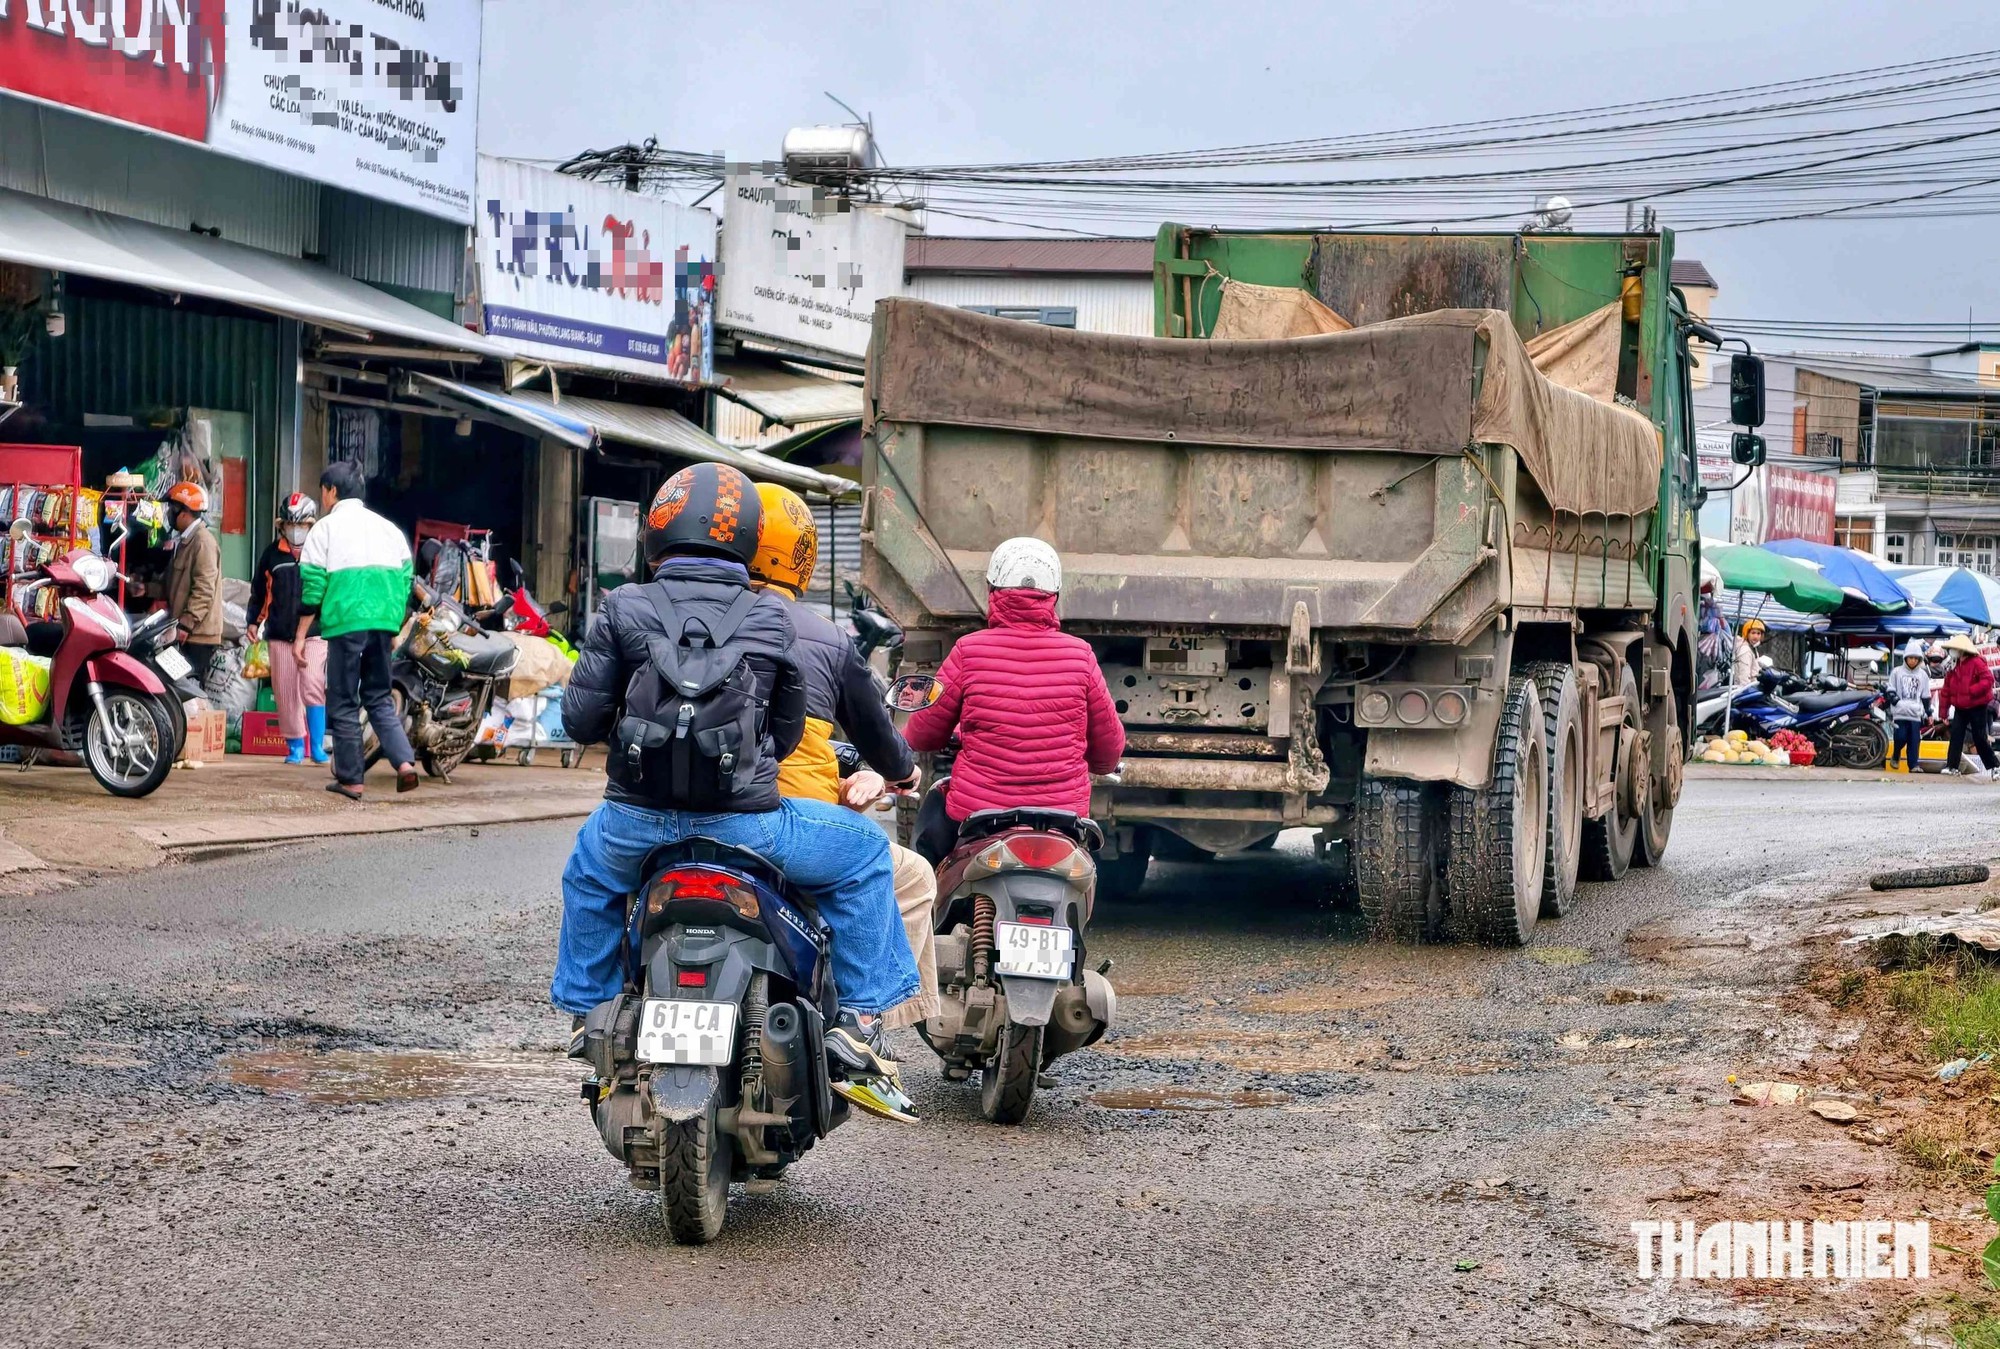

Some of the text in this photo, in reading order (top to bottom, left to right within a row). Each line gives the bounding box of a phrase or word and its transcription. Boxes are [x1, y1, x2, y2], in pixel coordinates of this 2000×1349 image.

[264, 75, 292, 93] CHUY
[269, 92, 286, 112] CÁC
[738, 187, 769, 206] BEAU
[1008, 926, 1059, 951] 49-B1
[652, 1003, 720, 1031] 61-CA
